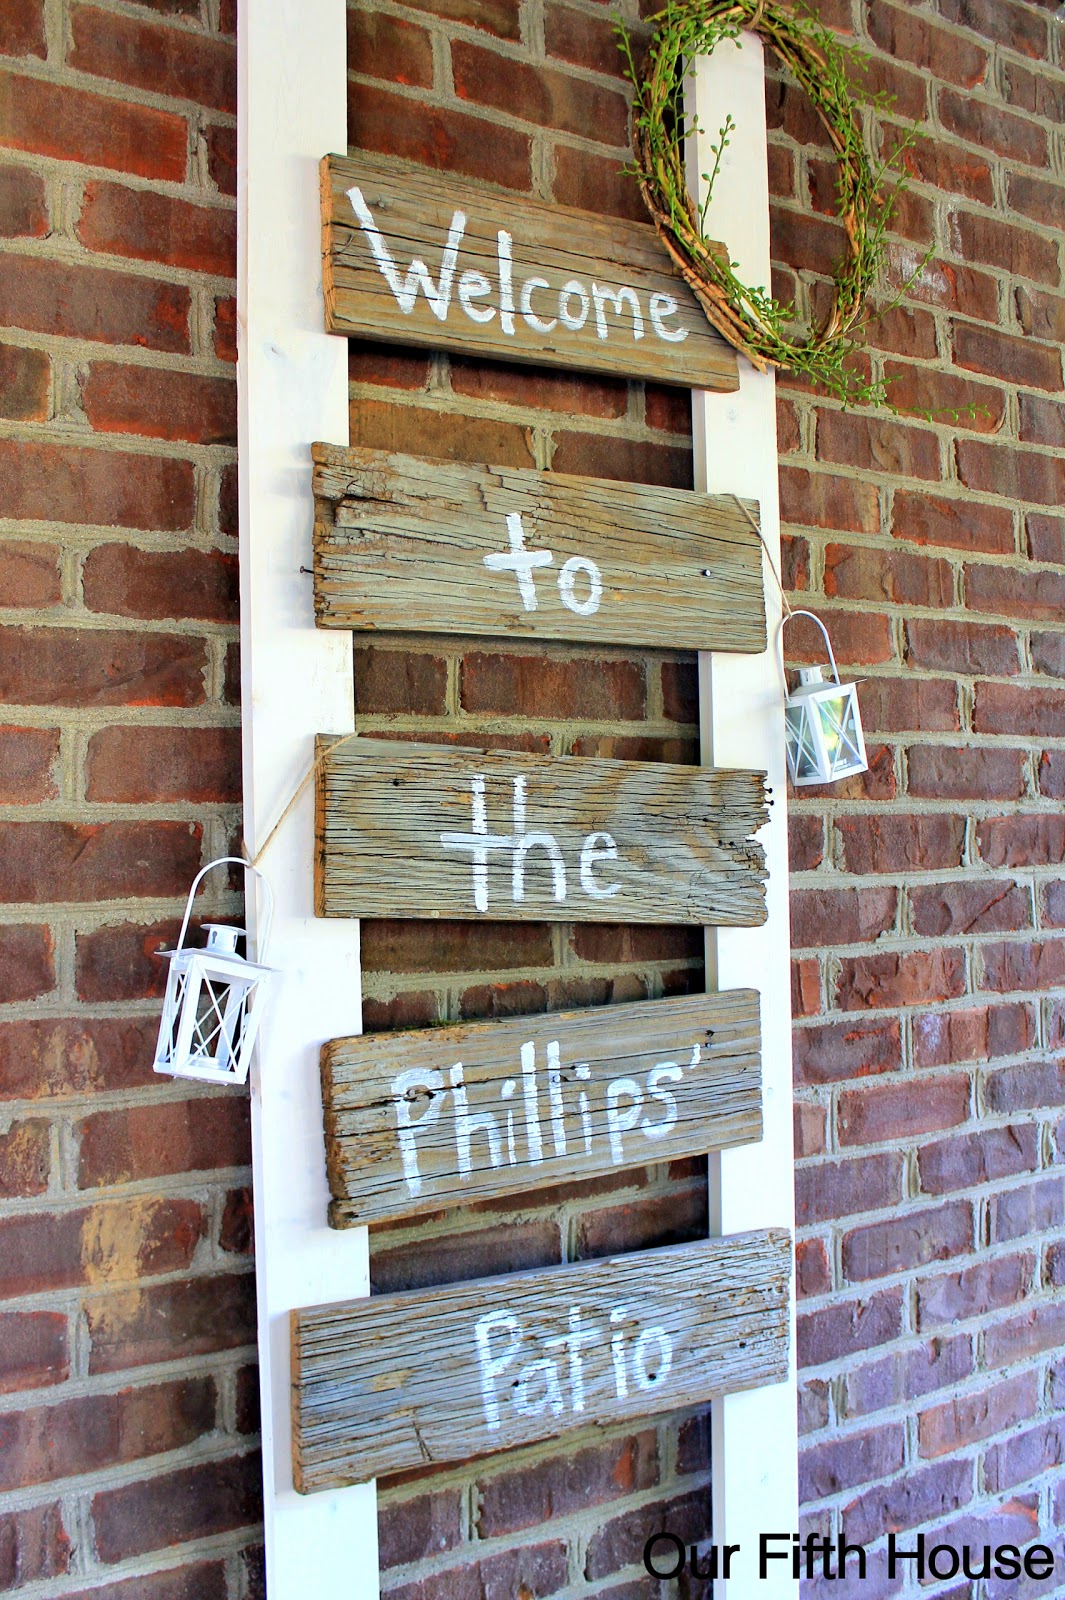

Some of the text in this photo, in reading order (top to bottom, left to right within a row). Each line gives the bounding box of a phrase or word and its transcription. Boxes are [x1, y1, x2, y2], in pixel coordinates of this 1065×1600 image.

[346, 187, 689, 343] Welcome
[483, 513, 603, 616] to
[440, 775, 622, 912] the
[391, 1041, 701, 1198] Phillips'
[475, 1306, 673, 1432] Patio
